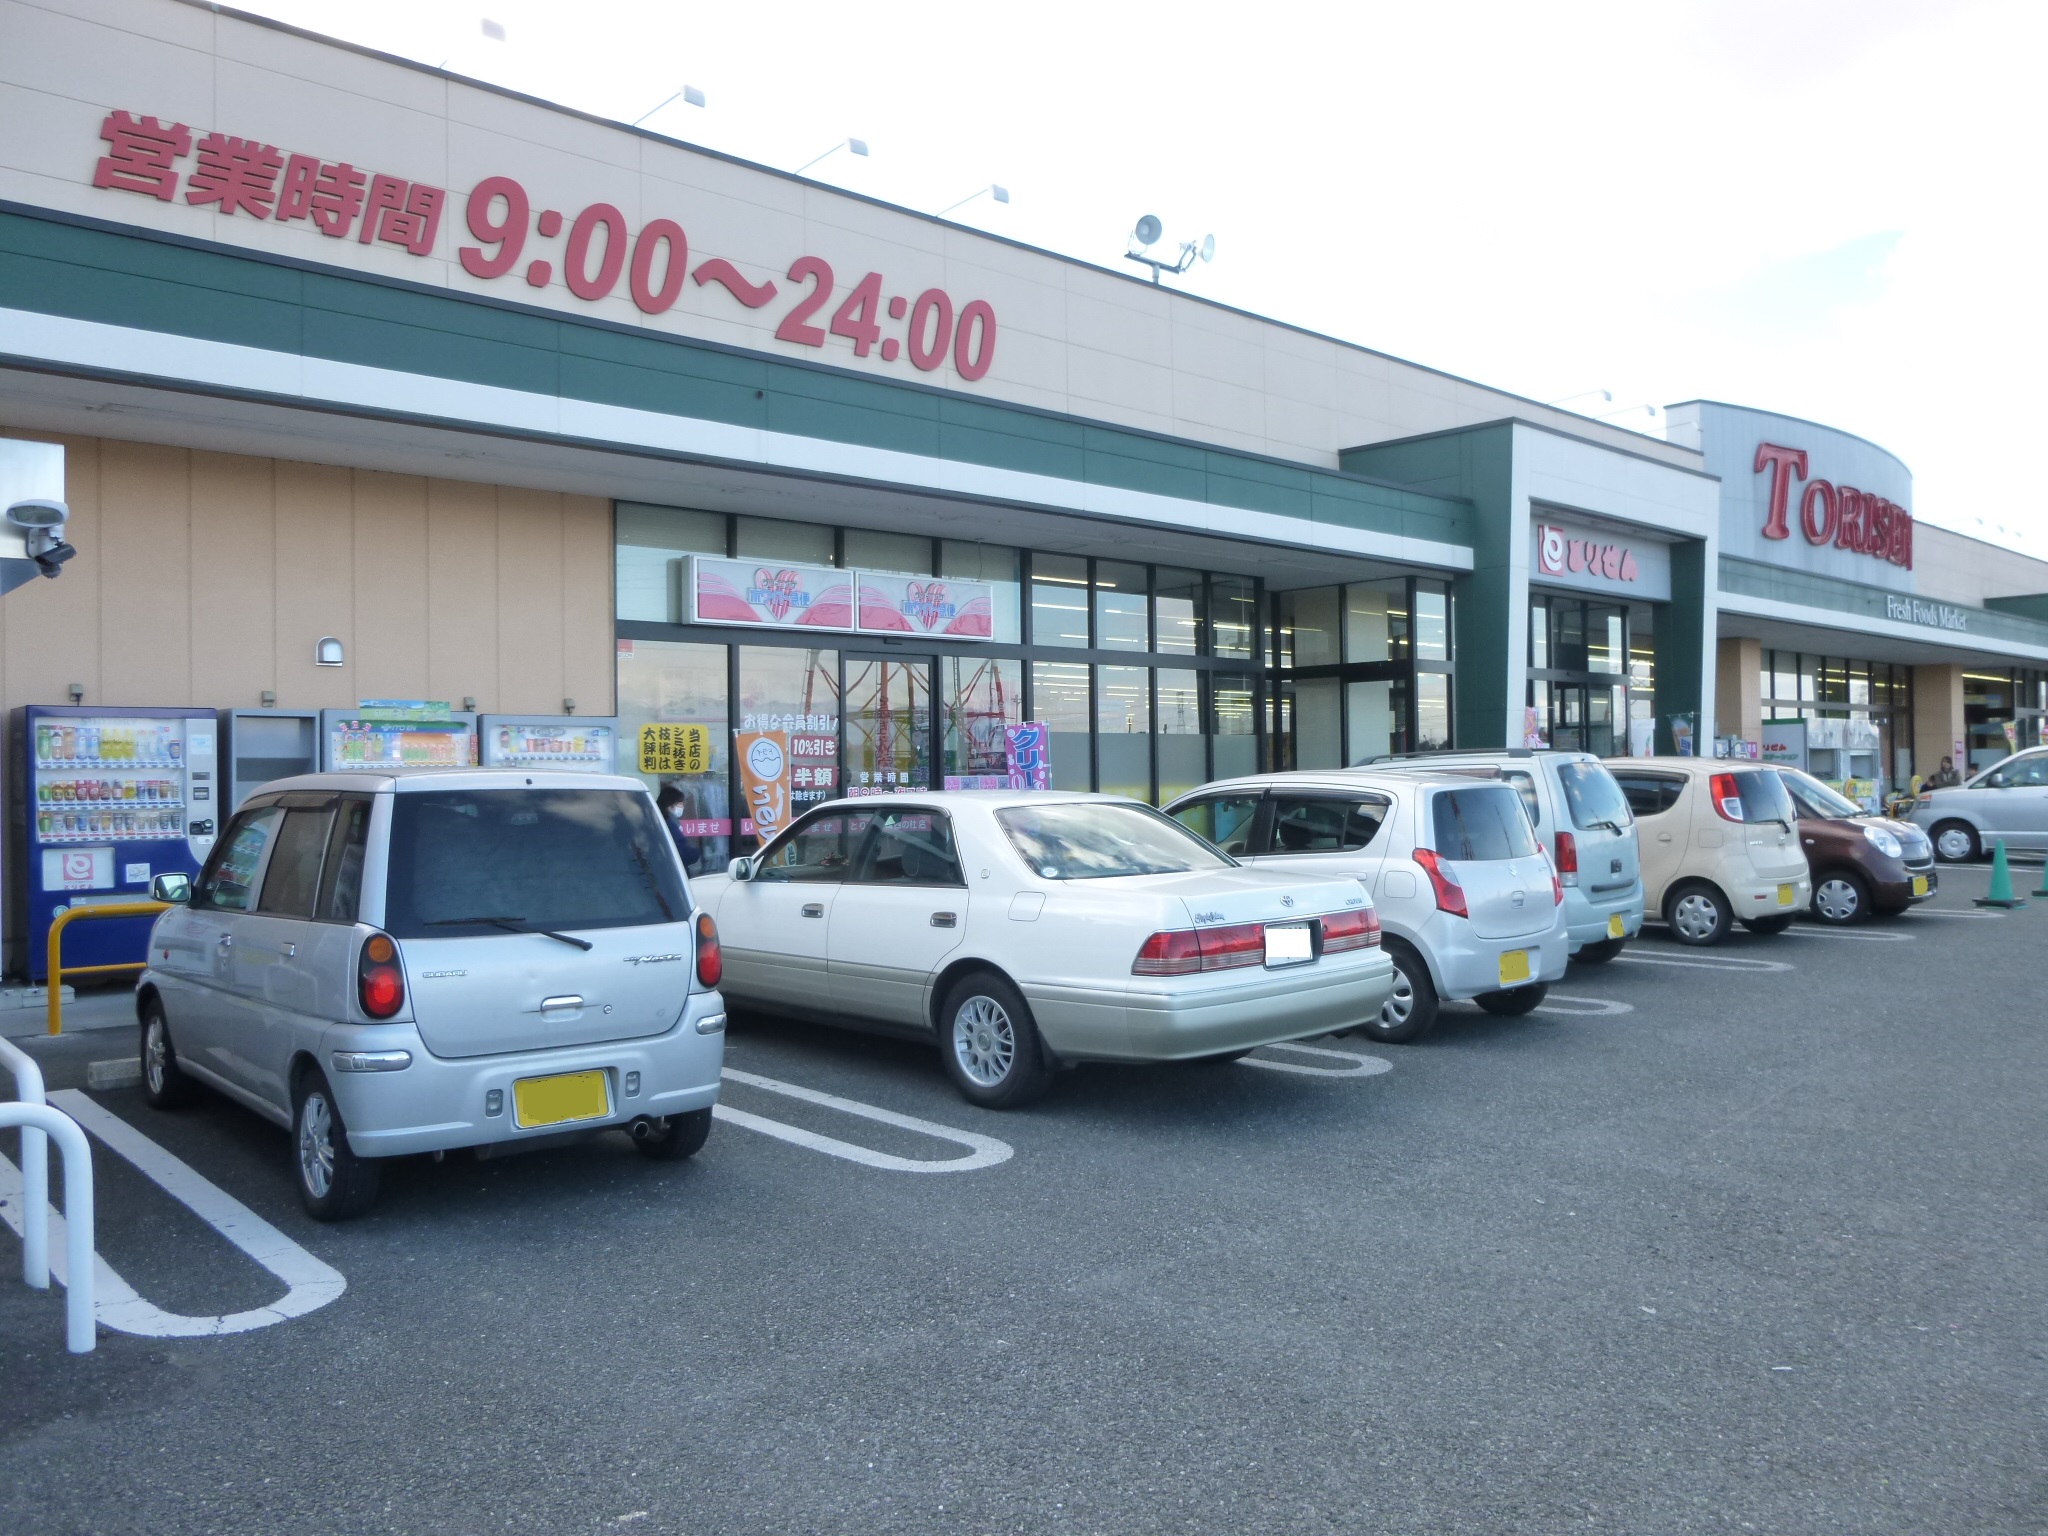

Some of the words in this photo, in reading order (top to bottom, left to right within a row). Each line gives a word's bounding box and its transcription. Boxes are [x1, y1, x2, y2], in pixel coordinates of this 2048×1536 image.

[93, 110, 446, 258] 営業時間
[1567, 539, 1639, 581] とりせん
[750, 589, 810, 606] ホワイト急便
[904, 602, 956, 618] ホワイト急便
[1887, 595, 1911, 621] Fresh
[1913, 600, 1938, 626] Foods
[1939, 606, 1967, 631] Market
[644, 727, 656, 770] 大評判
[659, 727, 671, 770] 技術は
[673, 727, 686, 770] シミ抜き
[689, 728, 701, 770] 当店の
[794, 739, 835, 756] 10%引き
[795, 767, 833, 786] 半額
[860, 771, 909, 783] 営業時間
[422, 969, 468, 979] SUBARU
